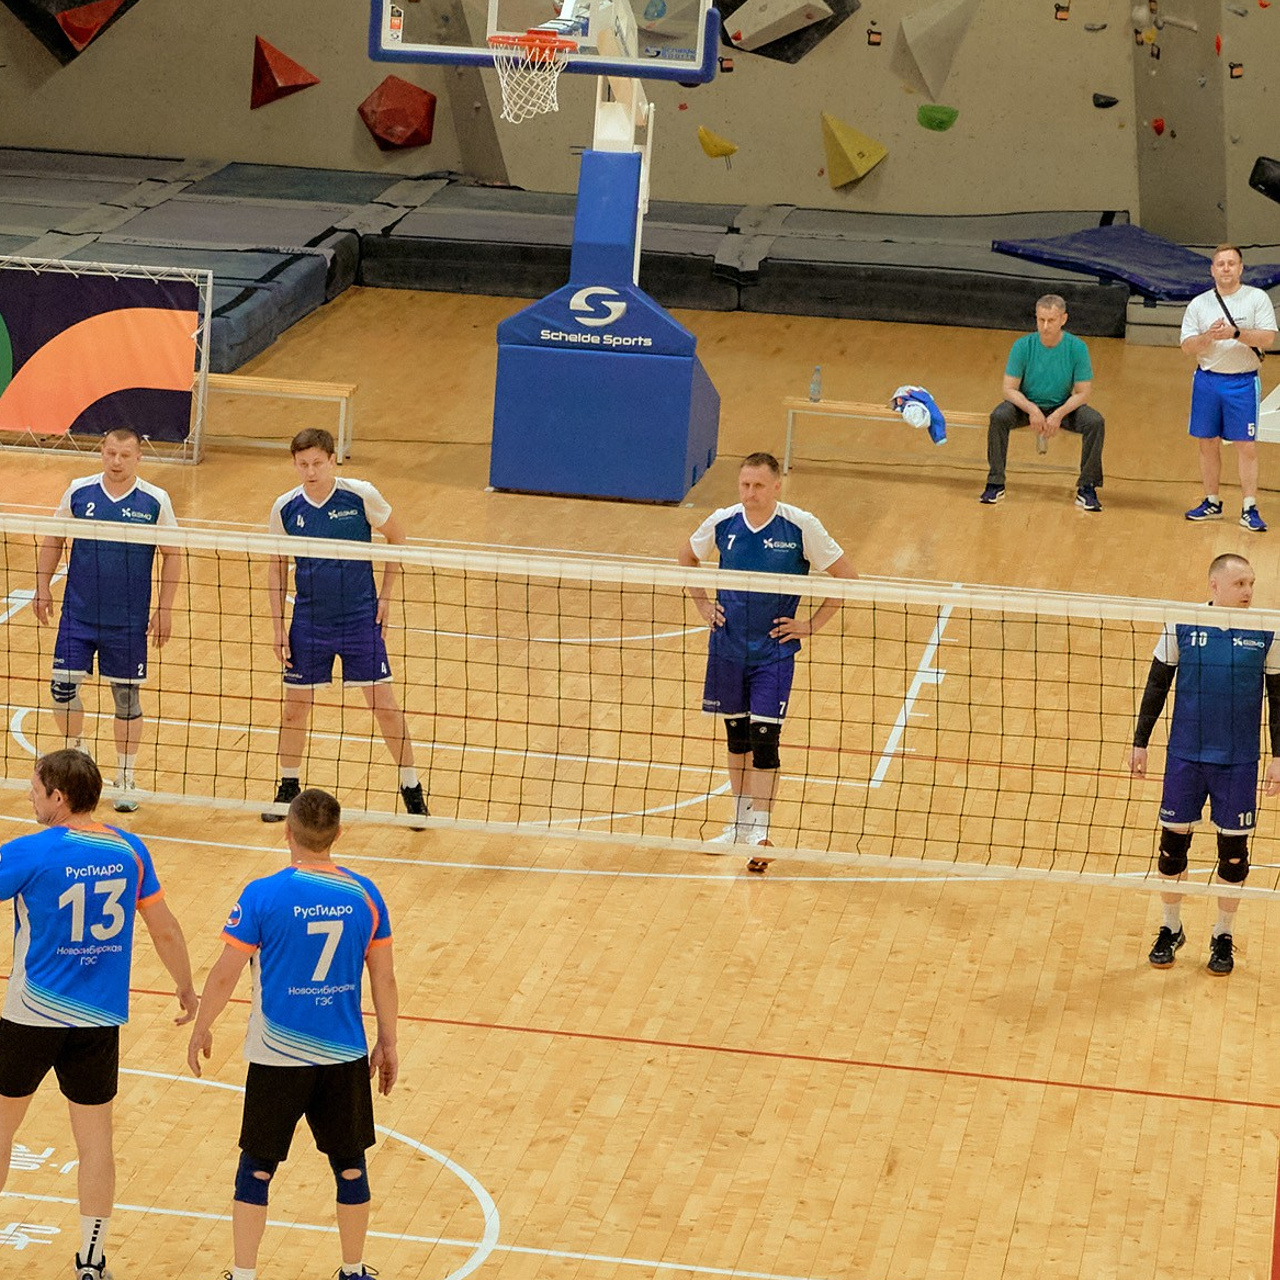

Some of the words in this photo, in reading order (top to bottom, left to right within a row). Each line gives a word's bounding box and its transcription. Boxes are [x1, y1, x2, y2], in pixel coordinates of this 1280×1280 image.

[540, 329, 600, 344] Schelde
[602, 334, 653, 347] Sports
[1247, 423, 1255, 437] 5
[85, 502, 96, 517] 2
[296, 514, 305, 528] 4
[727, 534, 736, 550] 7
[1190, 631, 1208, 647] 10
[137, 663, 144, 676] 2
[381, 661, 387, 675] 4
[779, 701, 787, 716] 7
[1238, 811, 1253, 827] 10
[65, 863, 124, 879] РусГидро
[58, 878, 127, 942] 13
[293, 904, 354, 919] РусГидро
[56, 944, 122, 956] Новосибирская
[307, 920, 344, 982] 7
[80, 956, 98, 966] ГЭС
[315, 996, 334, 1006] ГЭС
